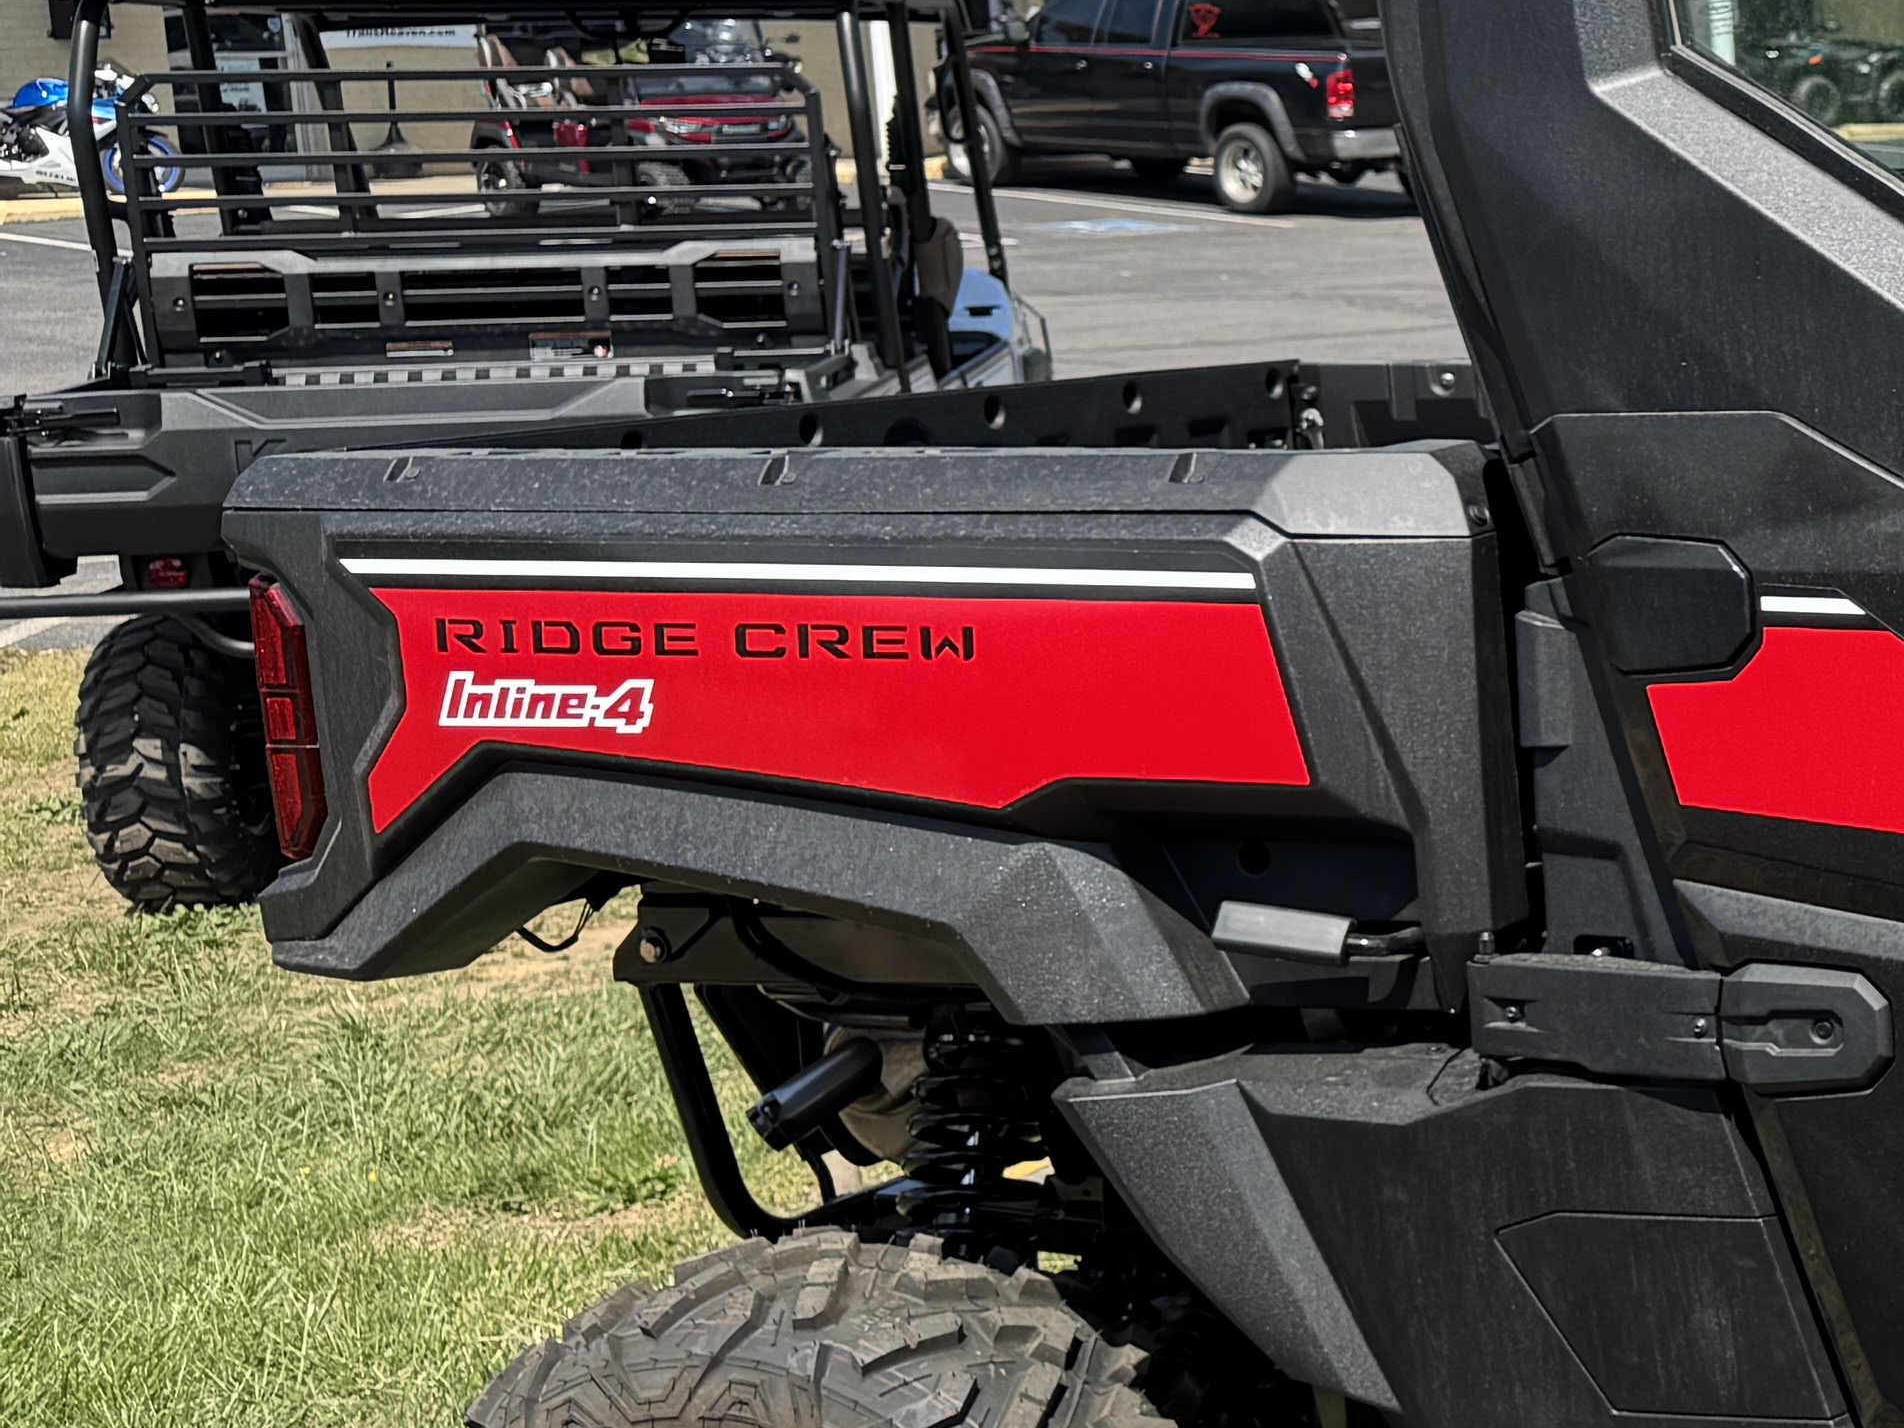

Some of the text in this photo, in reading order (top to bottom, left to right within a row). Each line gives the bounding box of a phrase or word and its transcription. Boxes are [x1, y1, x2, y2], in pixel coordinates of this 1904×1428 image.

[435, 618, 976, 662] RIDGE CREW
[438, 670, 655, 734] Inline-4
